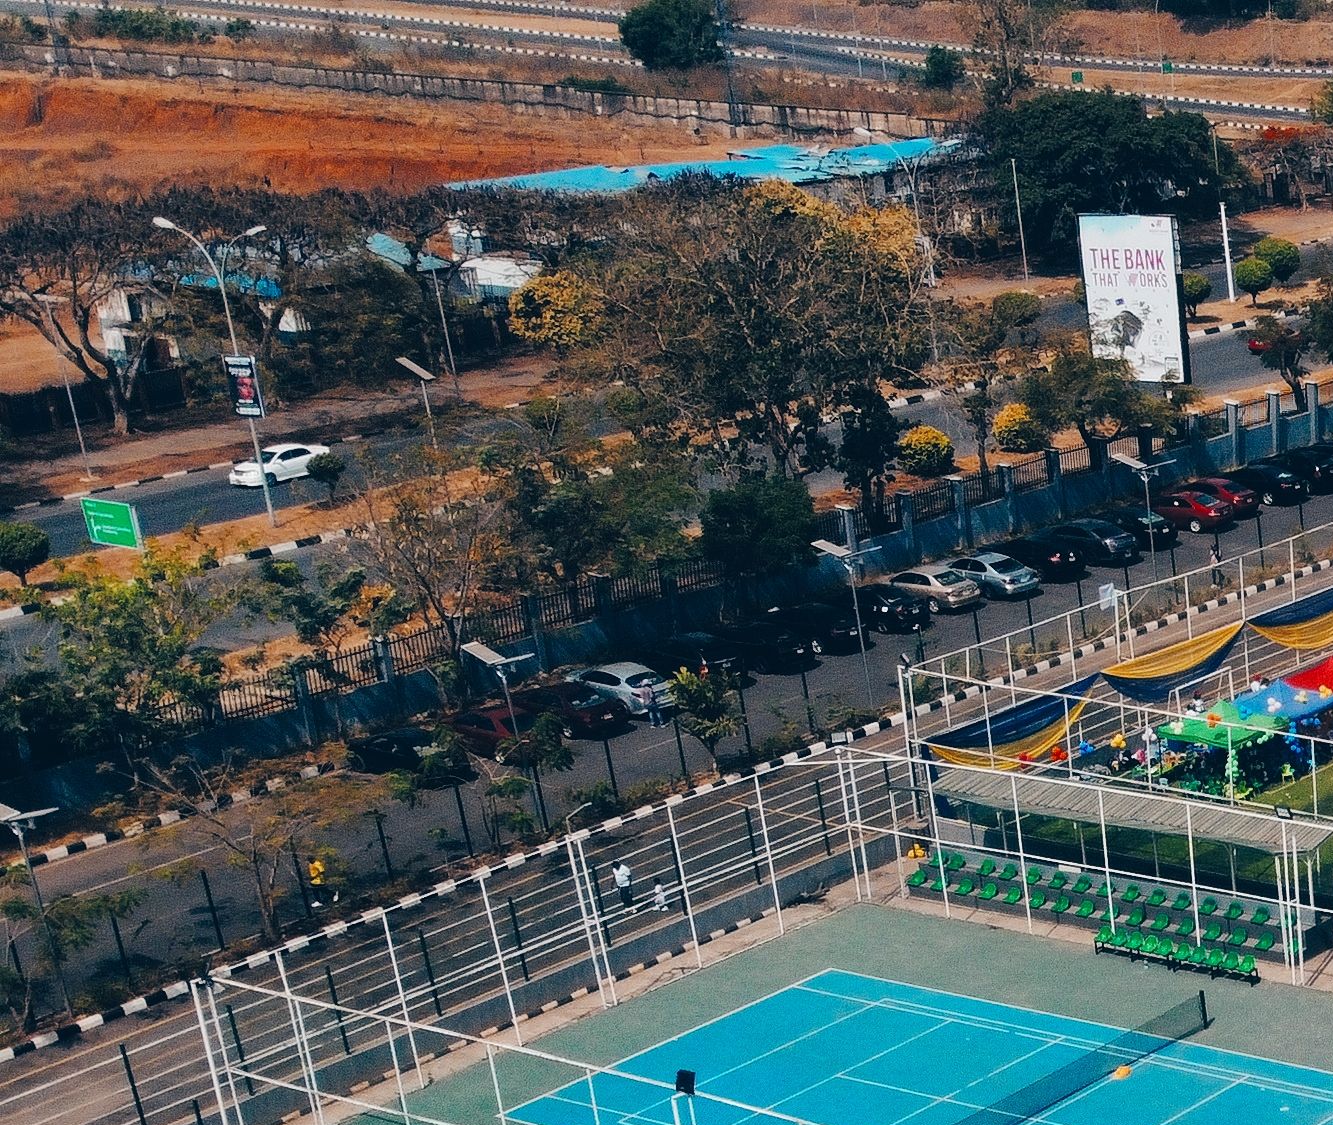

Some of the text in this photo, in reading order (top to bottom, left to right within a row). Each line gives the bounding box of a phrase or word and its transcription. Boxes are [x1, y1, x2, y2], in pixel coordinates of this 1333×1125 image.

[1089, 248, 1166, 271] THE BANK
[1093, 272, 1168, 288] THAT WORKS
